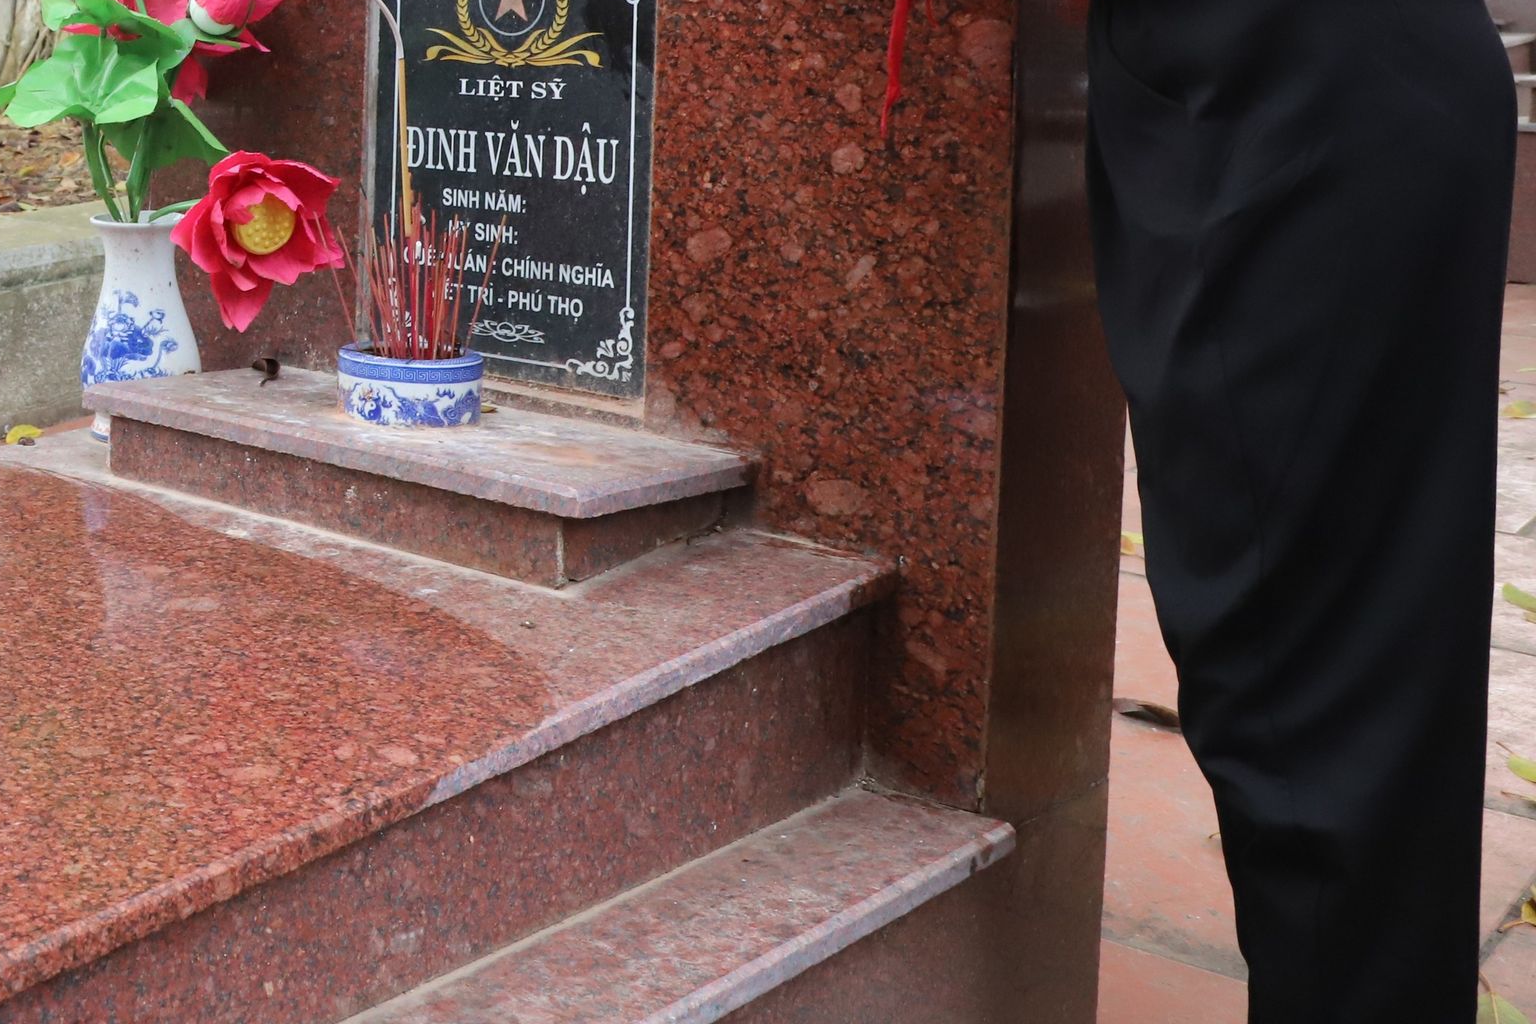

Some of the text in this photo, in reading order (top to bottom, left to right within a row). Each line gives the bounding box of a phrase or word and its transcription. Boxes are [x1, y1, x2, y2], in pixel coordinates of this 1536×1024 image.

[459, 75, 567, 101] LIỆT SỸ
[407, 120, 619, 195] ĐINH VĂN DẬU
[443, 188, 527, 213] SINH NĂM:
[475, 223, 518, 244] SINH:
[501, 256, 554, 281] CHÍNH
[559, 262, 615, 289] NGHĨA
[467, 282, 494, 306] TRÌ
[507, 289, 542, 312] PHÚ
[547, 294, 584, 322] THỌ
